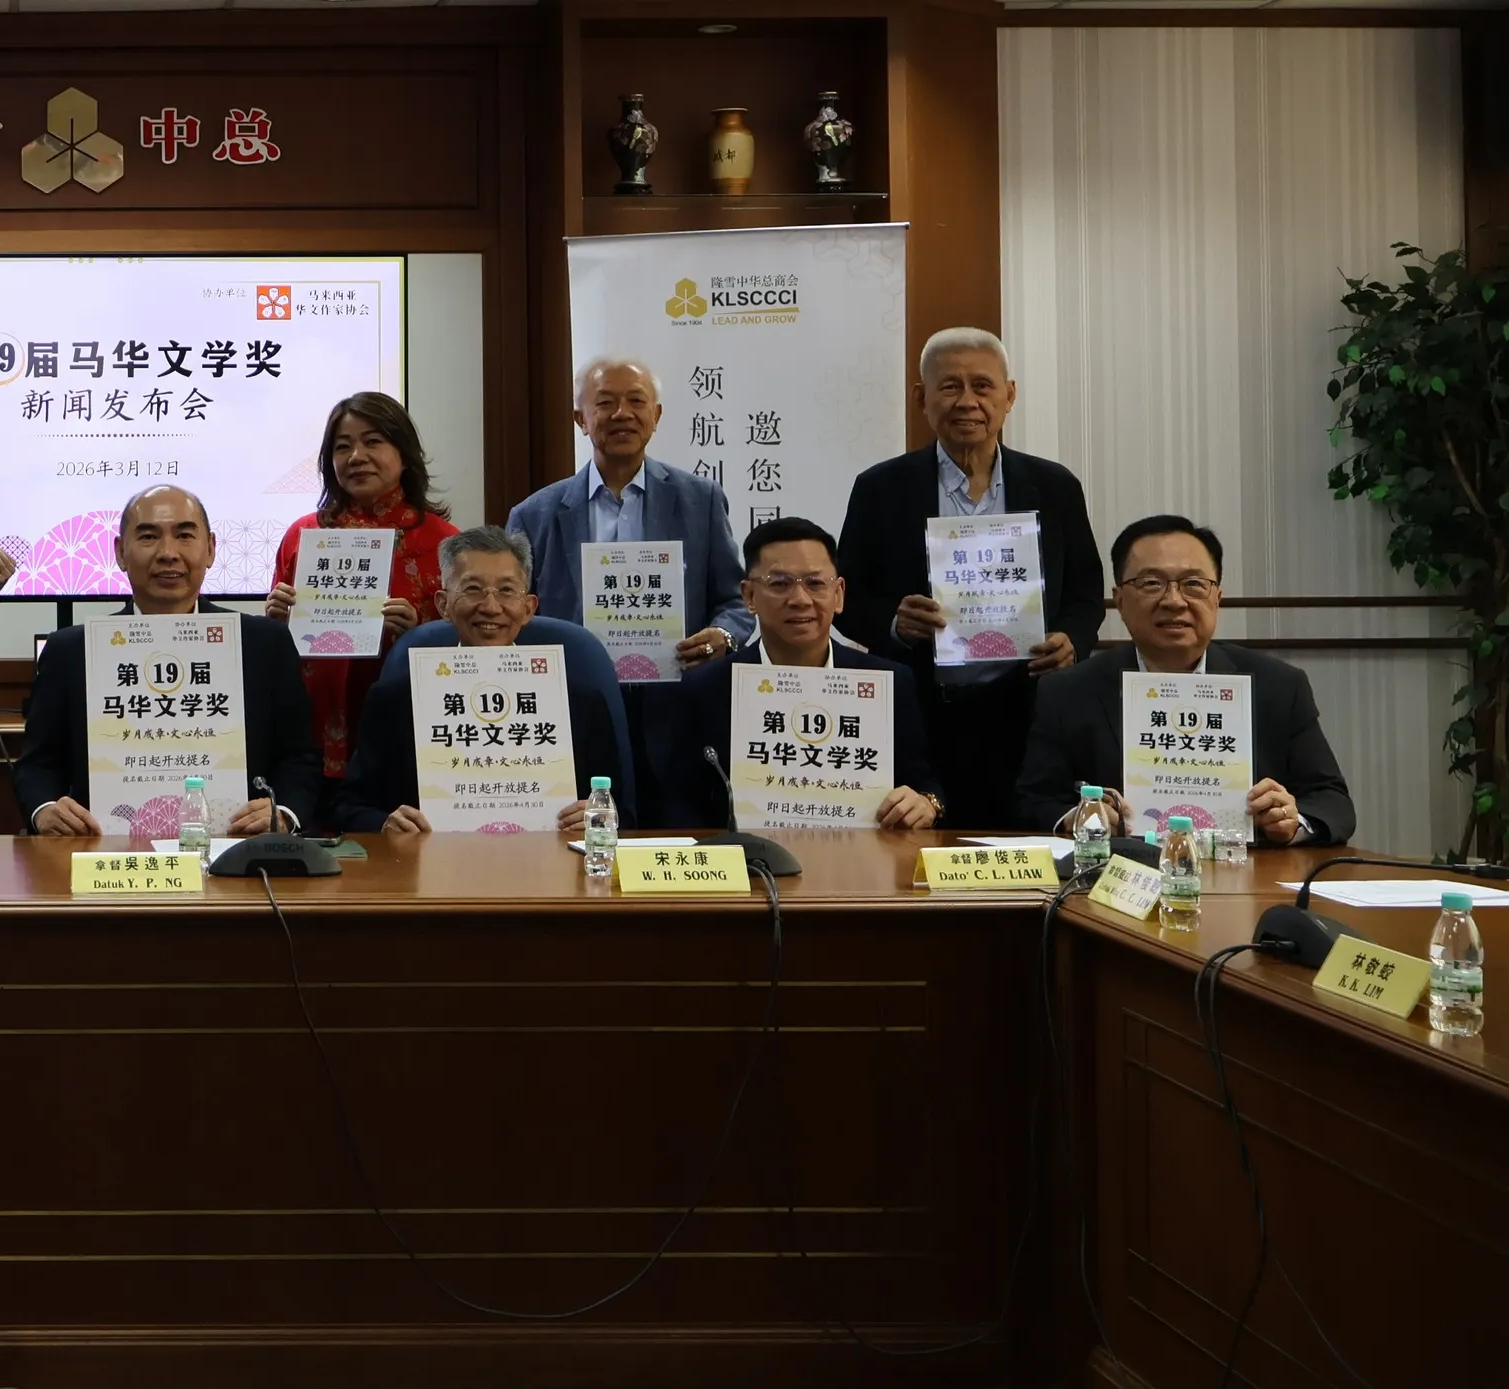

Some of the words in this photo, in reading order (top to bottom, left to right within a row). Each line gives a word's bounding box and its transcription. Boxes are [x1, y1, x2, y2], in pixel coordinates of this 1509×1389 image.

[140, 108, 281, 165] 中总
[711, 273, 799, 289] 隆雪中华总商会
[309, 289, 357, 301] 马来西亚
[711, 290, 797, 307] KLSCCCI
[296, 303, 370, 316] 华文作家协会
[712, 317, 738, 325] LEAD
[740, 316, 762, 324] AND
[764, 315, 796, 324] GROW
[20, 387, 215, 423] 新闻发布会
[56, 460, 181, 478] 2026年3月12日
[306, 575, 378, 589] 马华文学奖
[944, 567, 1027, 585] 马华文学奖
[595, 593, 672, 609] 马华文学奖
[102, 693, 229, 719] 马华文学奖
[431, 722, 557, 748] 马华文学奖
[1139, 732, 1236, 753] 马华文学奖
[124, 753, 211, 768] 即日起开放提名
[747, 741, 879, 772] 马华文学奖
[455, 781, 540, 795] 即日起开放提名
[767, 801, 856, 818] 即日起开放提名
[655, 851, 708, 866] 宋永康
[642, 871, 656, 880] W.
[664, 871, 676, 880] H.
[684, 870, 727, 880] SOONG
[974, 870, 988, 880] C.
[992, 870, 1005, 880] L.
[1009, 869, 1043, 880] LIAW
[94, 880, 124, 889] Datuk
[128, 878, 138, 888] Y.
[146, 878, 157, 888] P.
[165, 878, 182, 888] NG
[1363, 982, 1384, 1000] LIM
